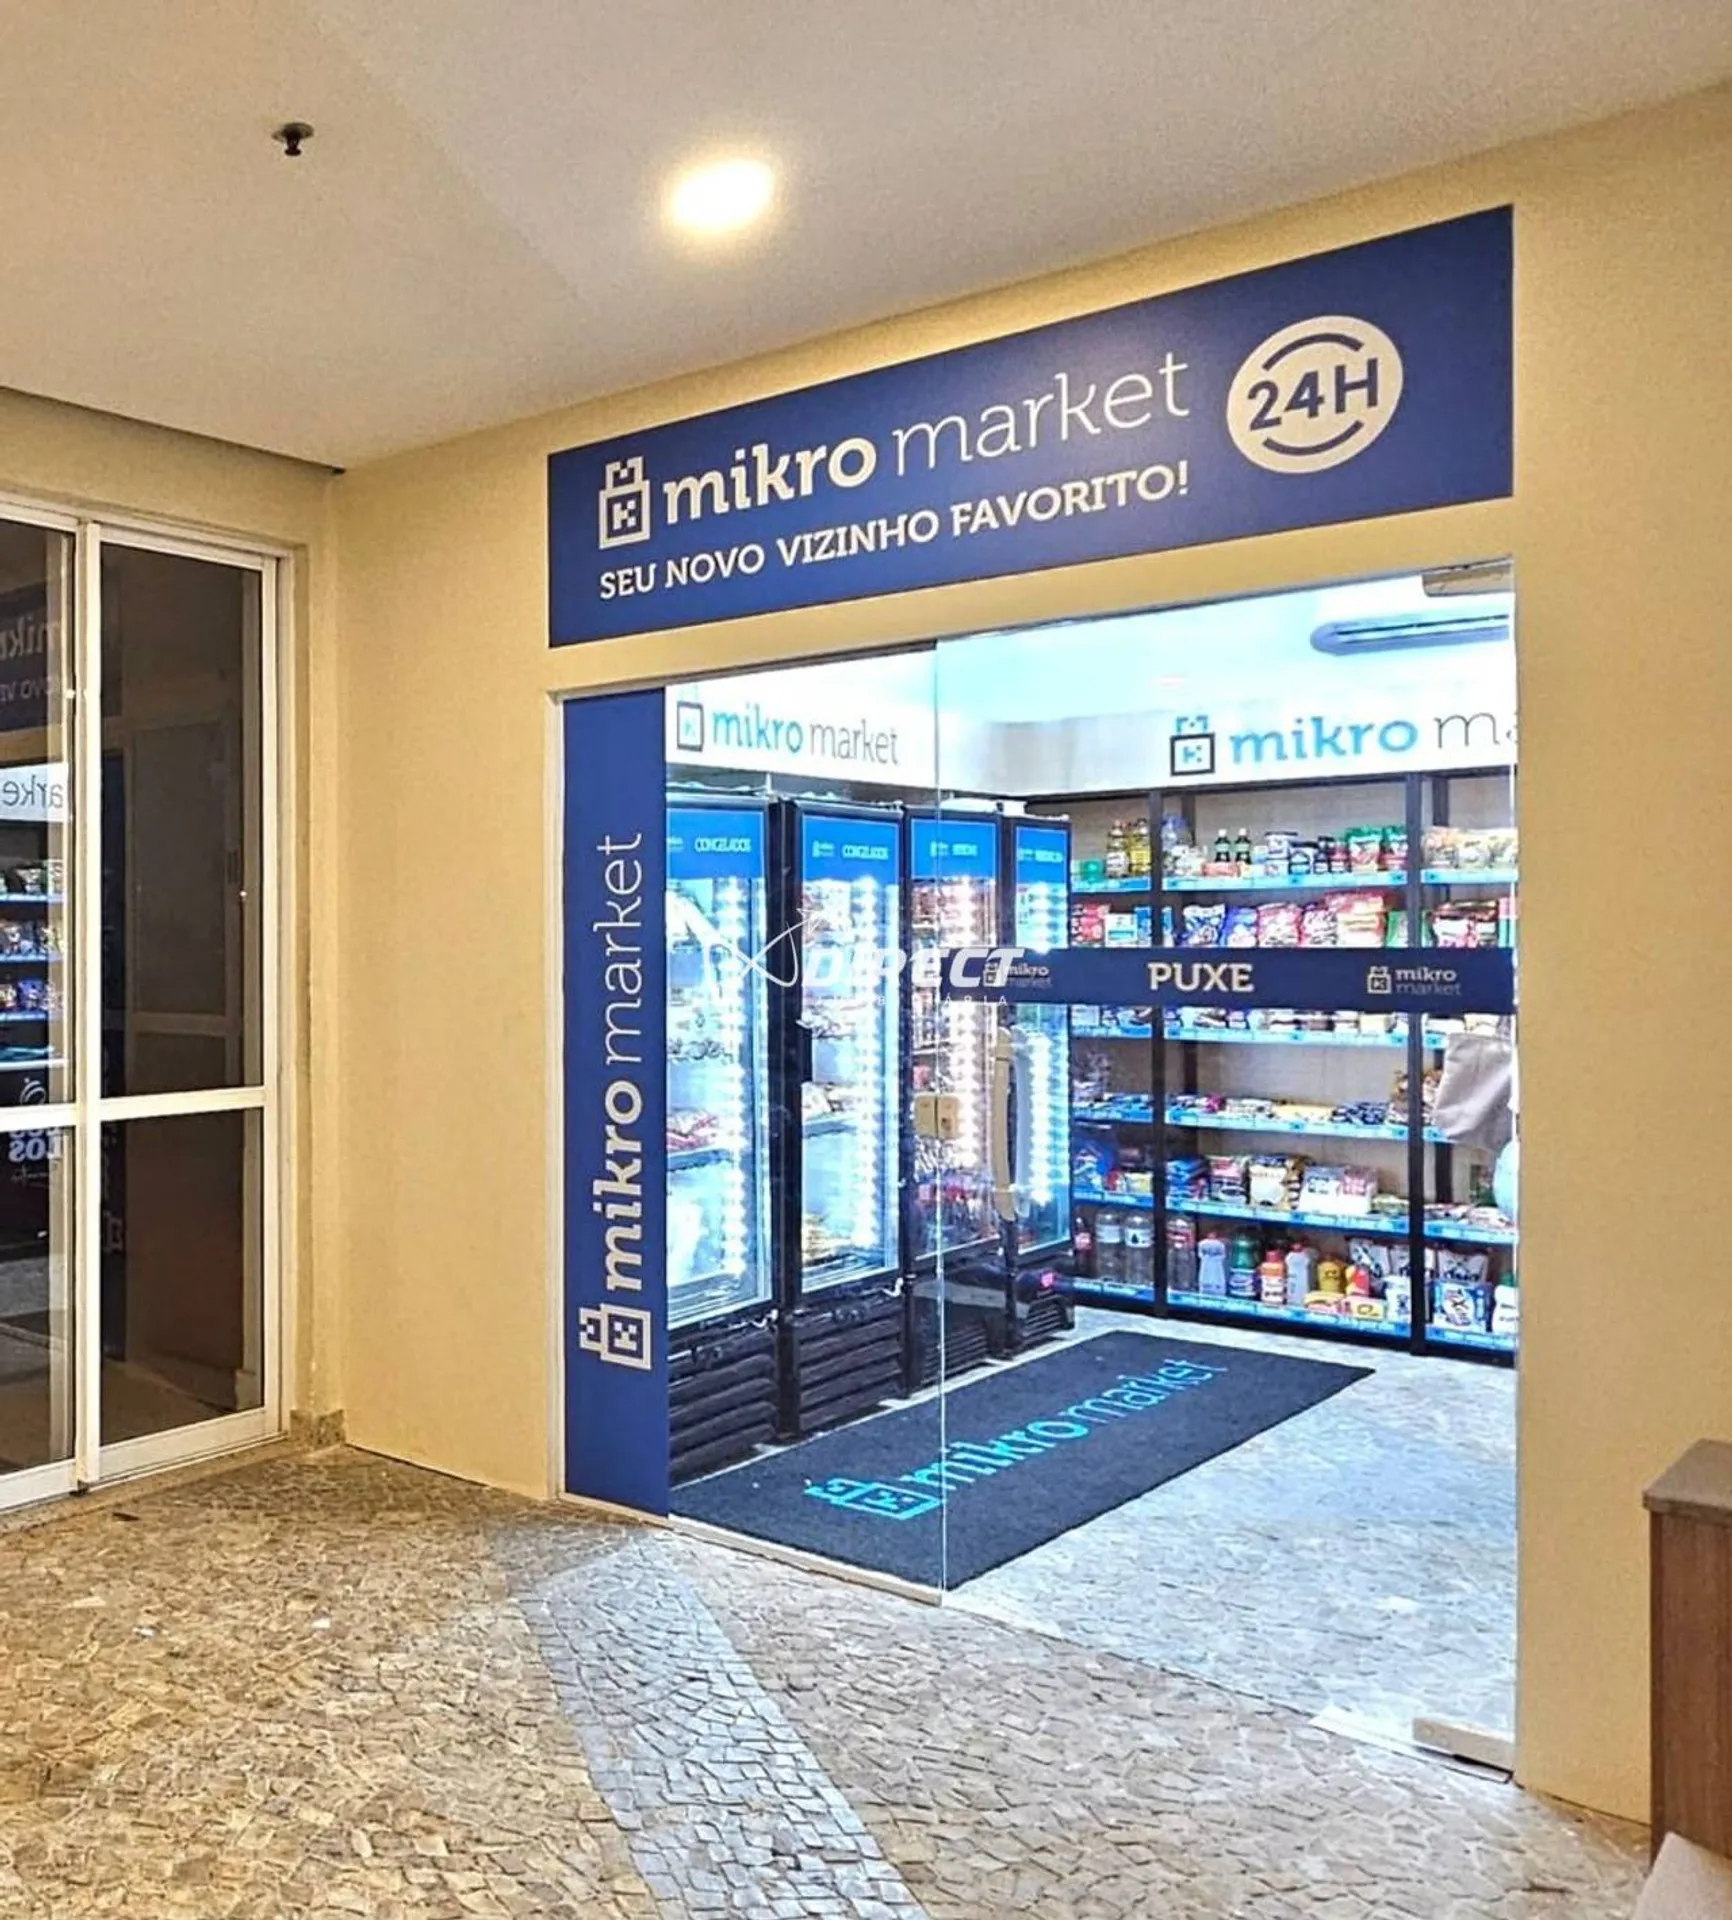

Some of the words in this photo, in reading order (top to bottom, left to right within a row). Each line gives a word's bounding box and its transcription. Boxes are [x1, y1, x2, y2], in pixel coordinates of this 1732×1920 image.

[1247, 357, 1379, 431] 24H
[662, 436, 877, 526] mikro
[891, 351, 1190, 477] market
[599, 563, 657, 600] SEU
[664, 543, 766, 589] NOVO
[775, 508, 940, 567] VIZINHO
[950, 460, 1189, 538] FAVORITO!
[712, 702, 803, 754] mikro
[809, 718, 899, 765] market
[1228, 716, 1418, 765] mikro
[593, 832, 643, 1067] market
[1147, 962, 1255, 993] PUXE
[1395, 966, 1458, 983] mikro
[1395, 981, 1462, 997] market
[593, 1079, 643, 1292] mikro
[898, 1419, 1090, 1493] mikro
[1058, 1357, 1229, 1424] market
